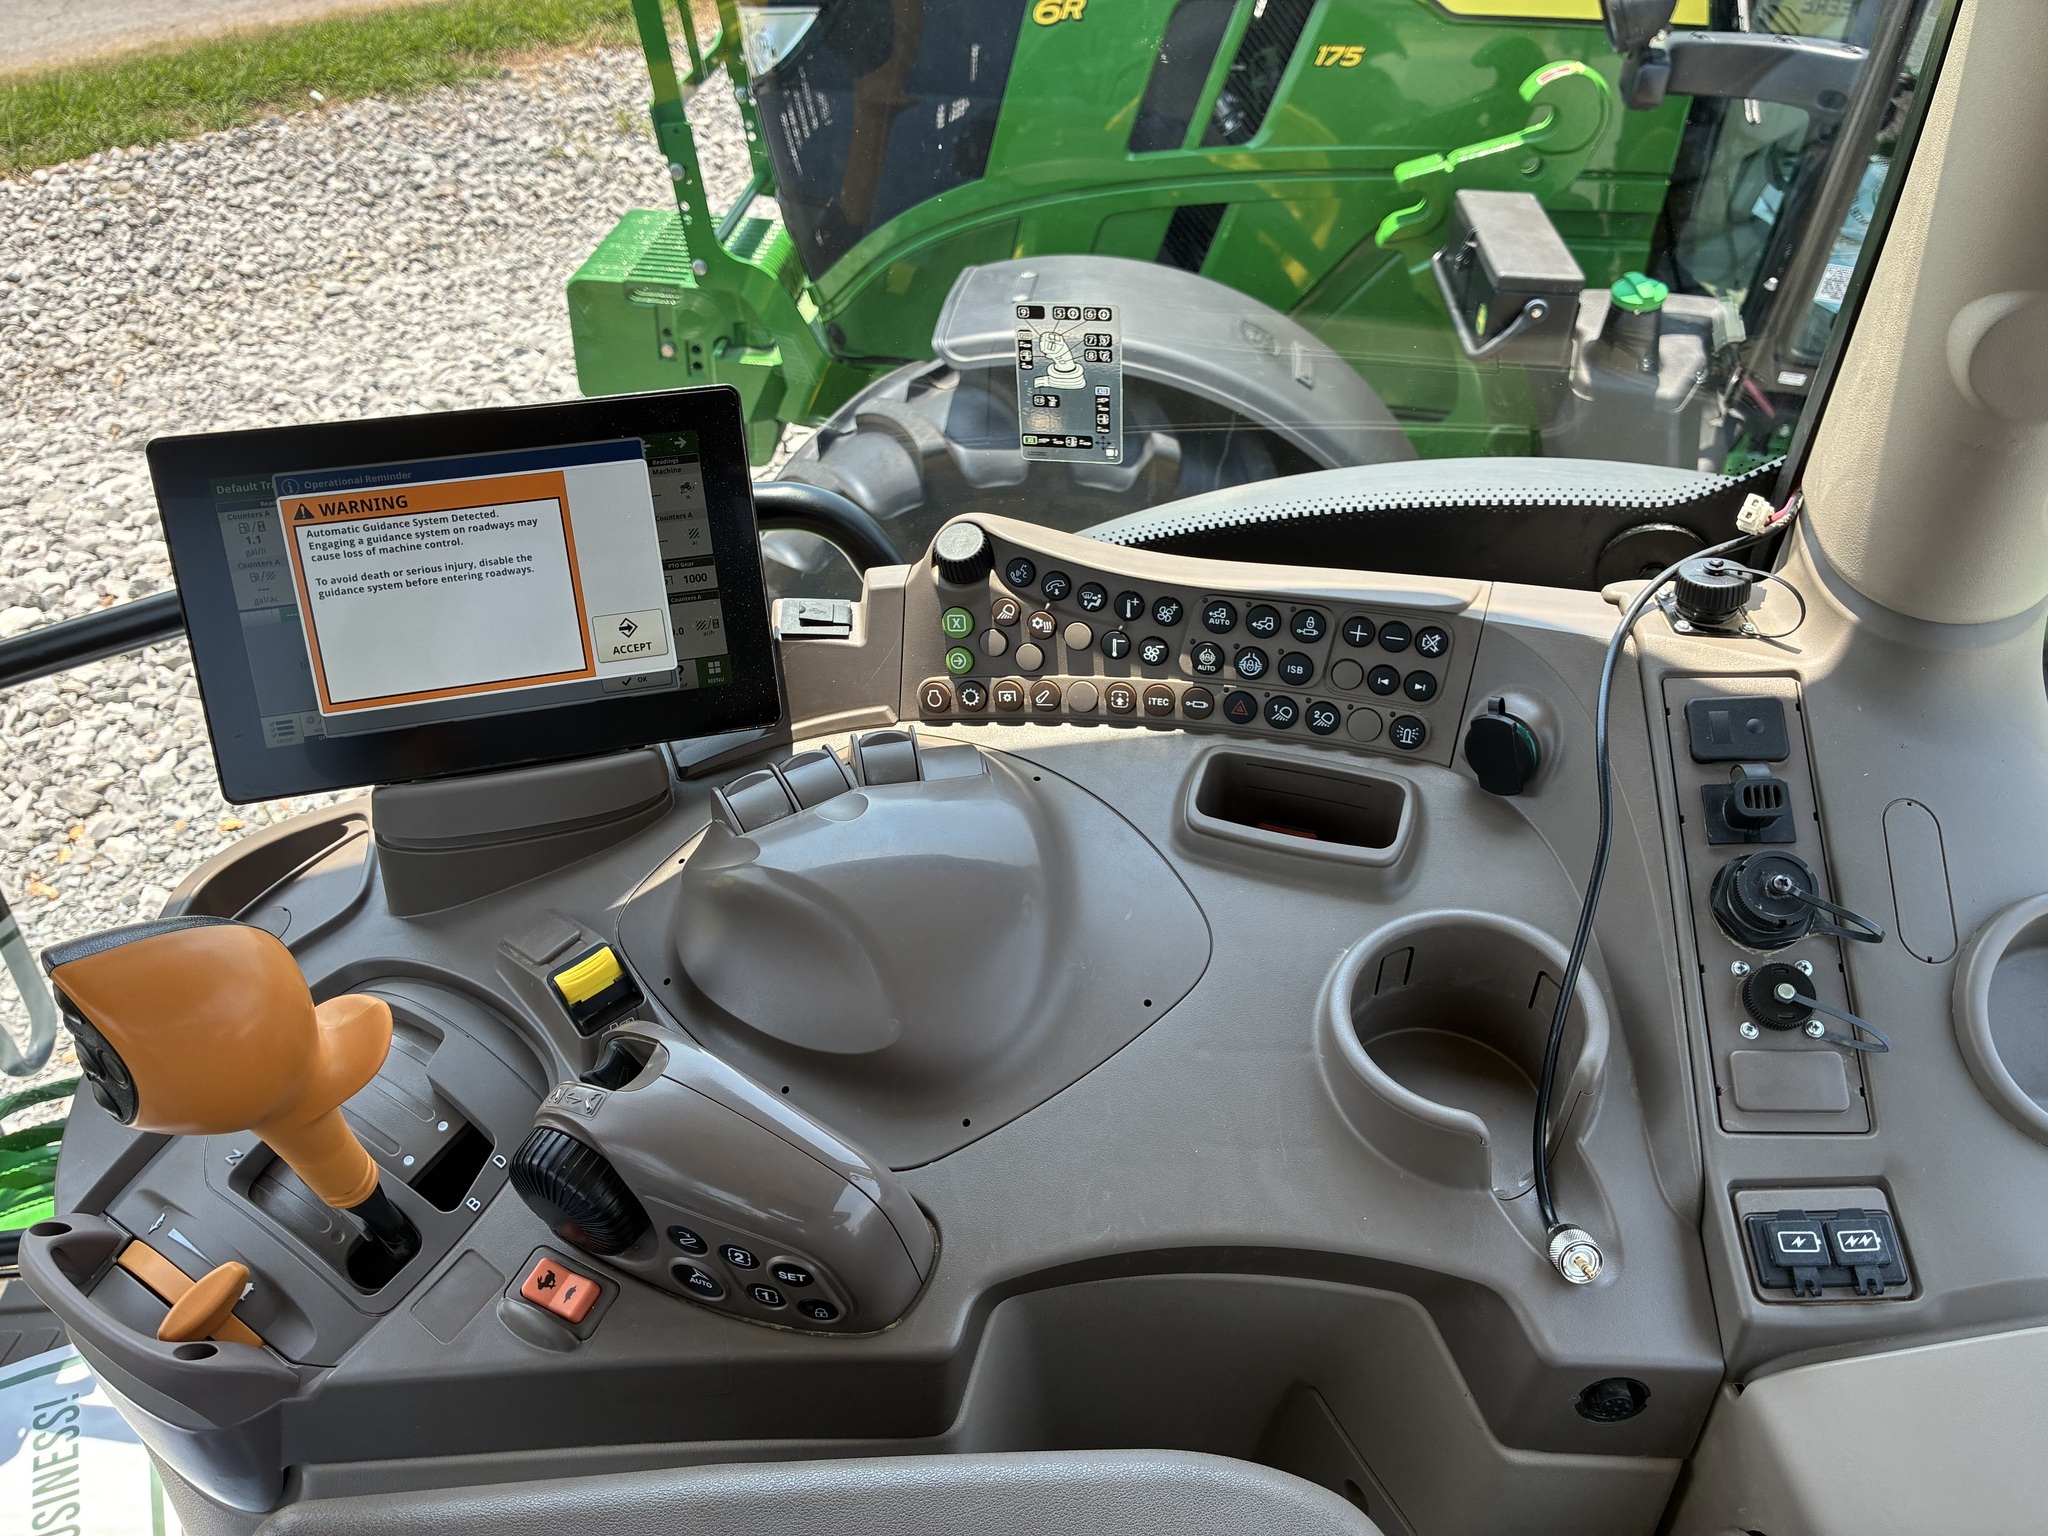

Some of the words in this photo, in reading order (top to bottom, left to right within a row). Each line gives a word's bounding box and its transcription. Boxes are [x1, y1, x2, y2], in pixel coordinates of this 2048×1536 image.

[1031, 0, 1087, 26] 6R
[1313, 44, 1367, 68] 175
[652, 458, 679, 466] Readings
[652, 467, 682, 476] Machine
[304, 476, 363, 490] Operational
[365, 470, 412, 484] Reminder
[216, 481, 258, 494] Default
[318, 495, 408, 517] WARNING
[227, 512, 263, 521] Counters
[656, 513, 686, 521] Counters
[306, 525, 360, 538] Automatic
[363, 520, 410, 532] Guidance
[412, 515, 449, 528] System
[451, 510, 499, 522] Detected.
[246, 534, 262, 546] 1.1
[308, 538, 356, 551] Engaging
[366, 531, 412, 546] guidance
[415, 528, 450, 540] system
[453, 526, 465, 534] on
[468, 520, 515, 533] roadways
[517, 518, 538, 528] may
[245, 547, 267, 559] gal/h
[311, 552, 341, 562] cause
[343, 548, 363, 558] loss
[366, 547, 376, 556] of
[379, 542, 422, 555] machine
[424, 537, 464, 550] control.
[238, 560, 274, 570] Counters
[315, 578, 328, 586] To
[330, 574, 358, 585] avoid
[361, 570, 390, 581] death
[393, 569, 403, 577] or
[406, 564, 443, 576] serious
[445, 561, 477, 573] injury,
[479, 555, 514, 567] disable
[516, 554, 533, 562] the
[318, 584, 365, 600] guidance
[367, 580, 403, 594] system
[405, 576, 439, 587] before
[441, 572, 483, 584] entering
[485, 566, 534, 578] roadways.
[684, 573, 708, 584] 1000
[254, 595, 279, 606] gal/ac
[1209, 618, 1230, 626] AUTO
[613, 642, 652, 655] ACCEPT
[1198, 664, 1216, 672] AUTO
[1287, 665, 1303, 674] ISB
[1148, 693, 1170, 706] iTEC
[224, 1149, 244, 1166] N
[493, 1154, 507, 1168] D
[466, 1197, 480, 1212] B
[734, 1253, 744, 1263] 2
[778, 1270, 806, 1282] SET
[689, 1277, 713, 1289] AUTO
[761, 1292, 770, 1300] 1
